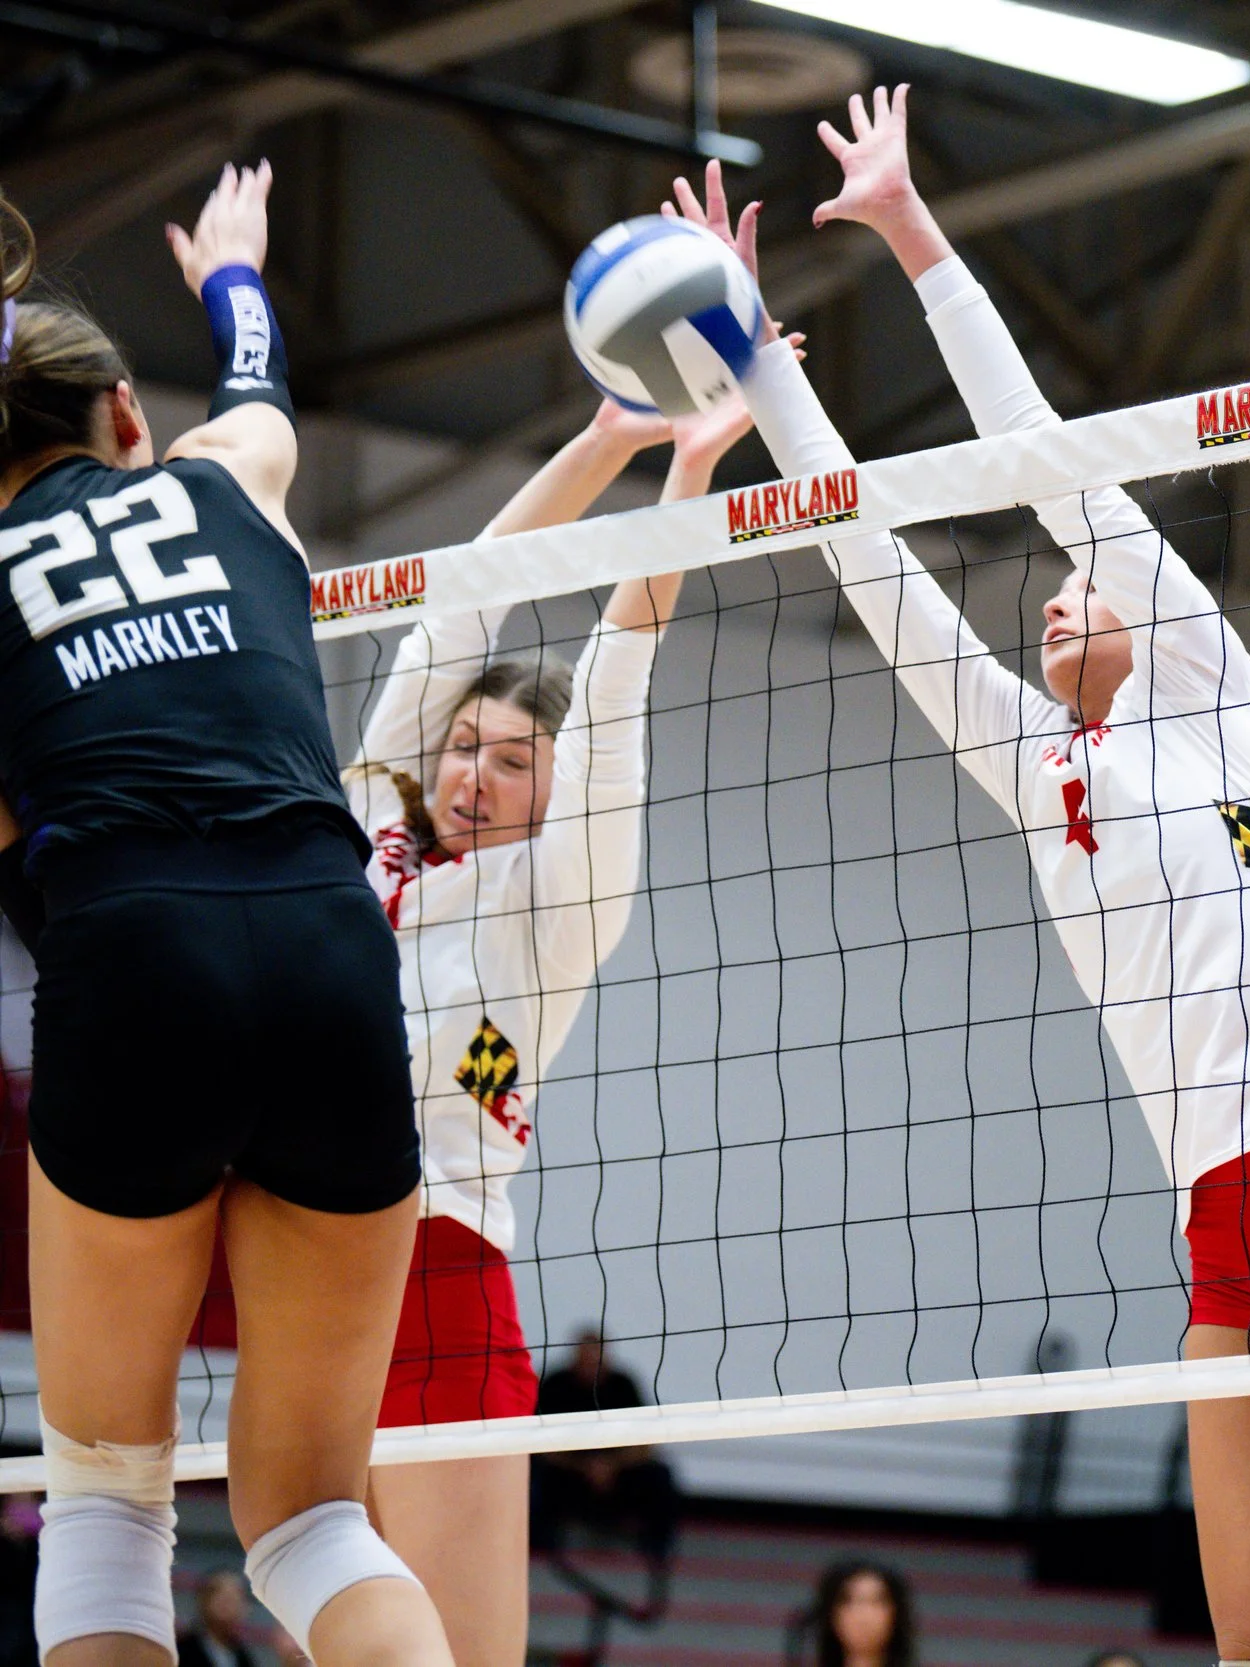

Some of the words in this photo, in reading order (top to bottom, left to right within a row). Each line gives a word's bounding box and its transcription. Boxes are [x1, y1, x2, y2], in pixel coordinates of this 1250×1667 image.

[727, 468, 859, 535] MARYLAND
[0, 471, 231, 641] 22
[311, 557, 425, 613] MARYLAND
[55, 605, 238, 690] MARKLEY
